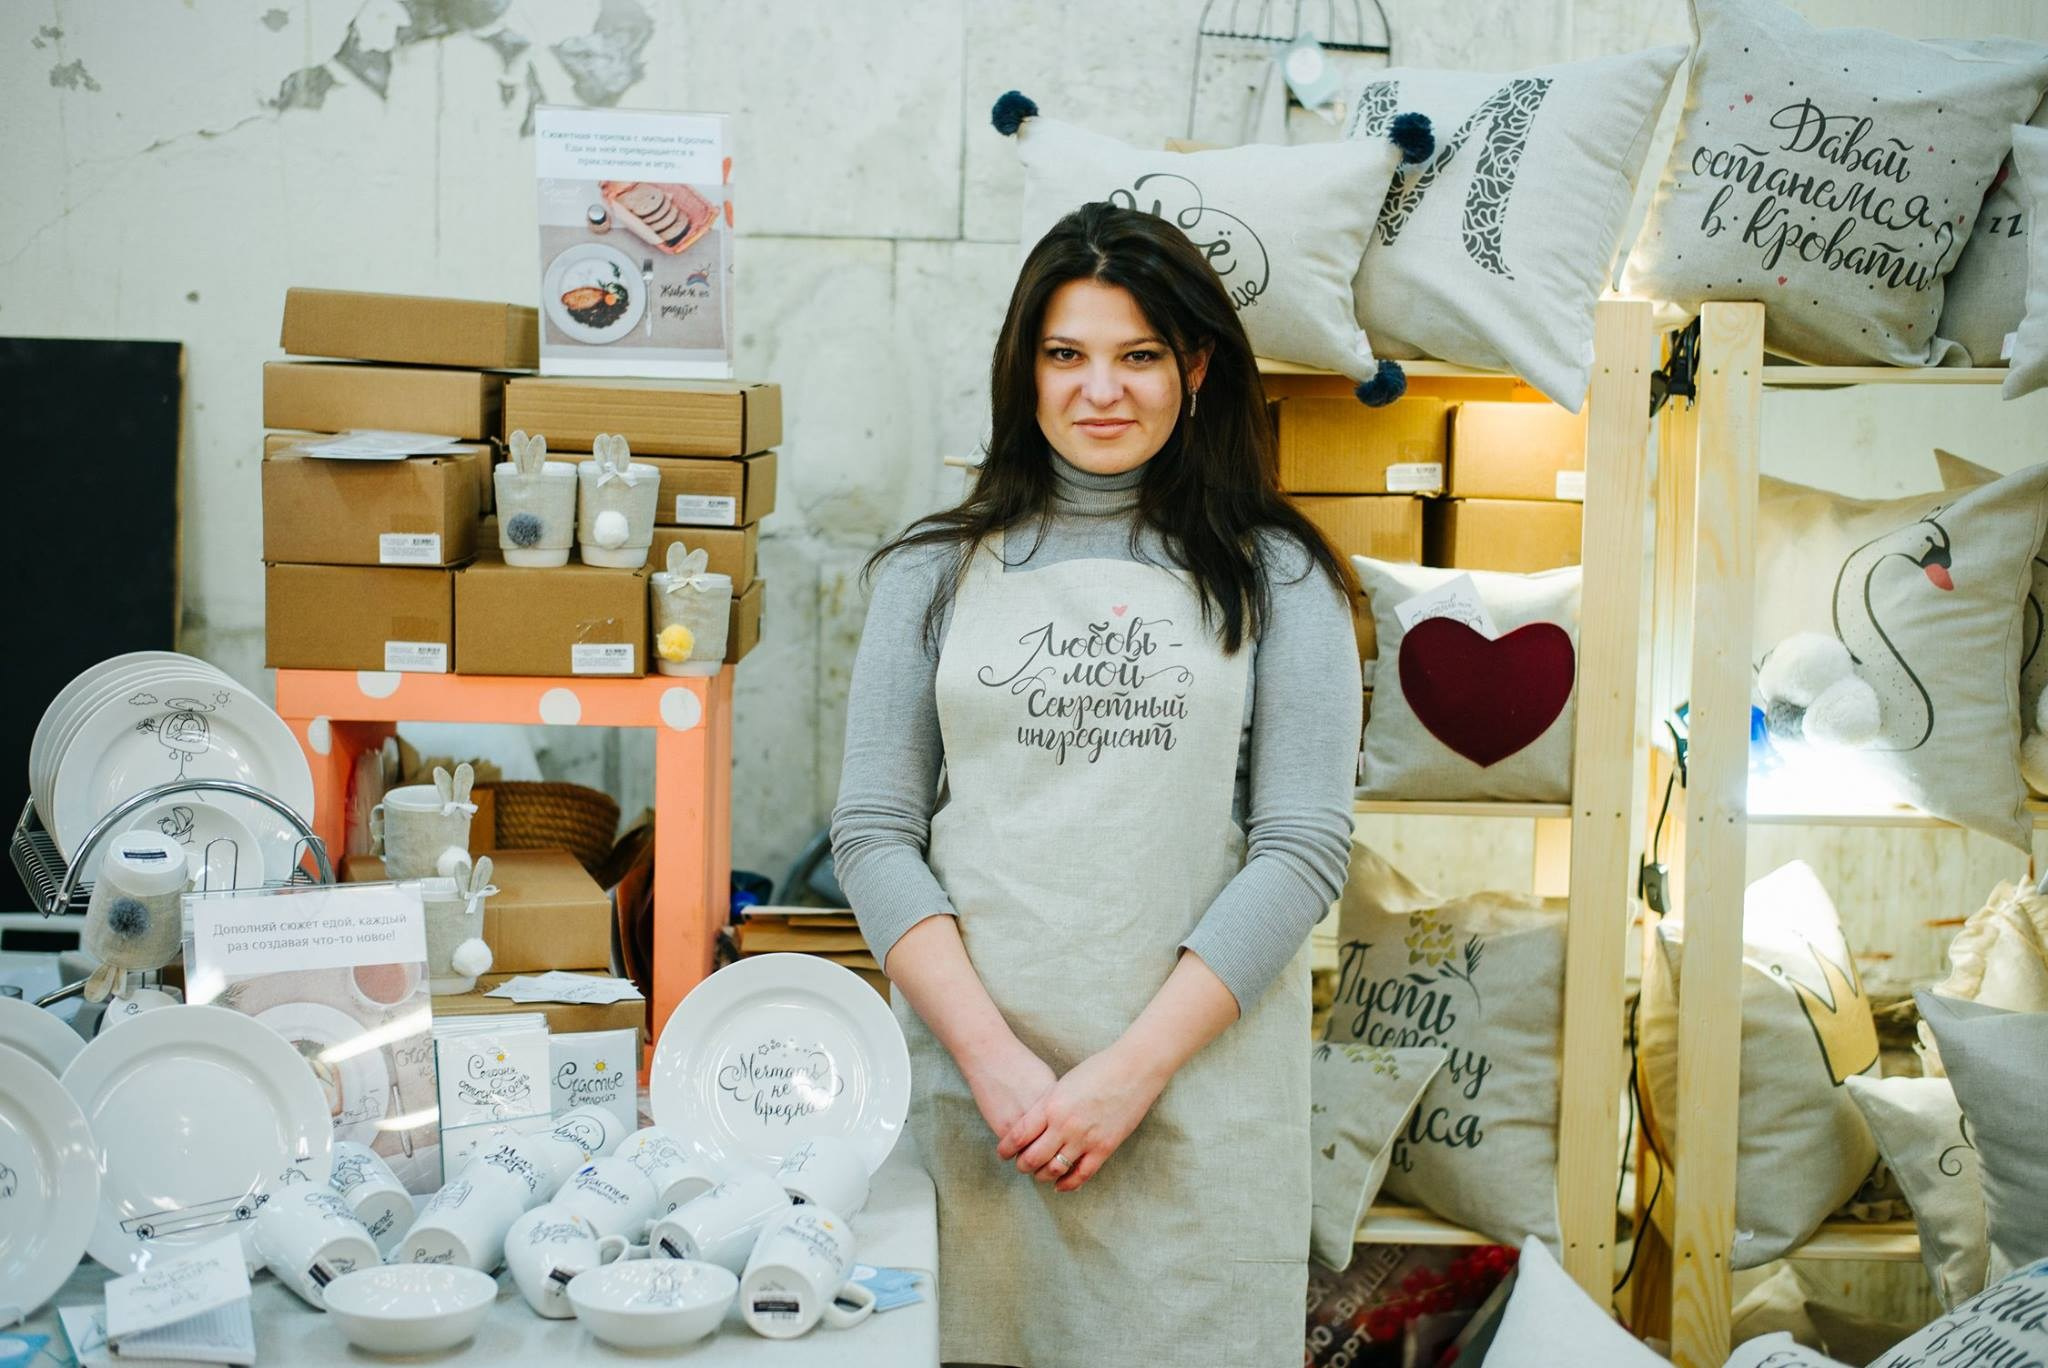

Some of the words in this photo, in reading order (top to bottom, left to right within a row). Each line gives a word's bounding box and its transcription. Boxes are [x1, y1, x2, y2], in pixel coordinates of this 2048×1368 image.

[1769, 97, 1914, 183] Давай
[1692, 143, 1932, 231] останемся
[1700, 184, 1734, 238] в
[977, 616, 1174, 687] Любовь
[1062, 656, 1194, 688] мой
[1018, 722, 1177, 766] ингредиент
[212, 921, 277, 937] Дополняй
[280, 919, 319, 932] сюжет
[322, 916, 355, 929] едой,
[358, 912, 407, 927] каждый
[227, 941, 249, 954] раз
[252, 936, 309, 951] создавая
[312, 933, 353, 946] что-то
[357, 930, 396, 944] новое!
[1334, 939, 1456, 1040] Пусть
[754, 1089, 817, 1126] вредно
